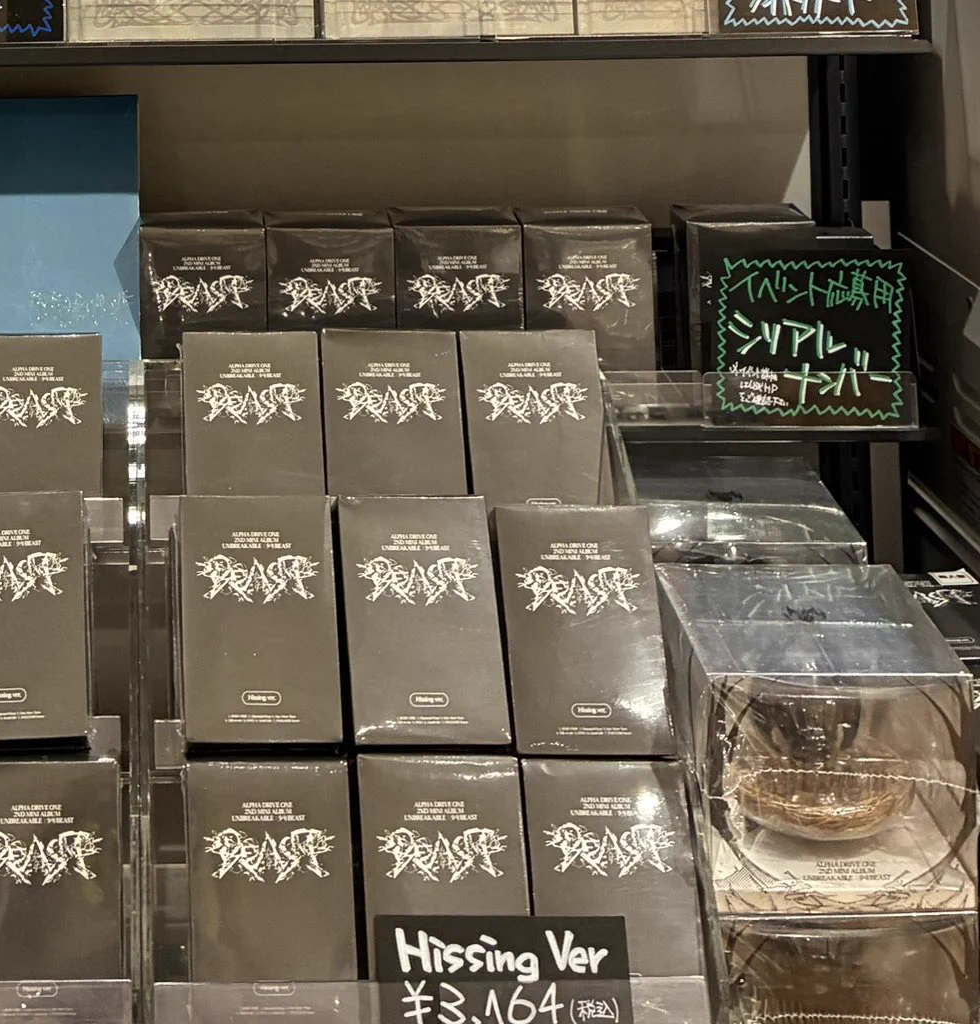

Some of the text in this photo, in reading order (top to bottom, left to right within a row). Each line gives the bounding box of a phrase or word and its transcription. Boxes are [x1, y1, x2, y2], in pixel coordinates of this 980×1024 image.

[728, 310, 847, 359] シリアル
[783, 347, 893, 404] ナンバー
[394, 927, 609, 983] Hissing Ver
[401, 979, 565, 1024] ¥3,164
